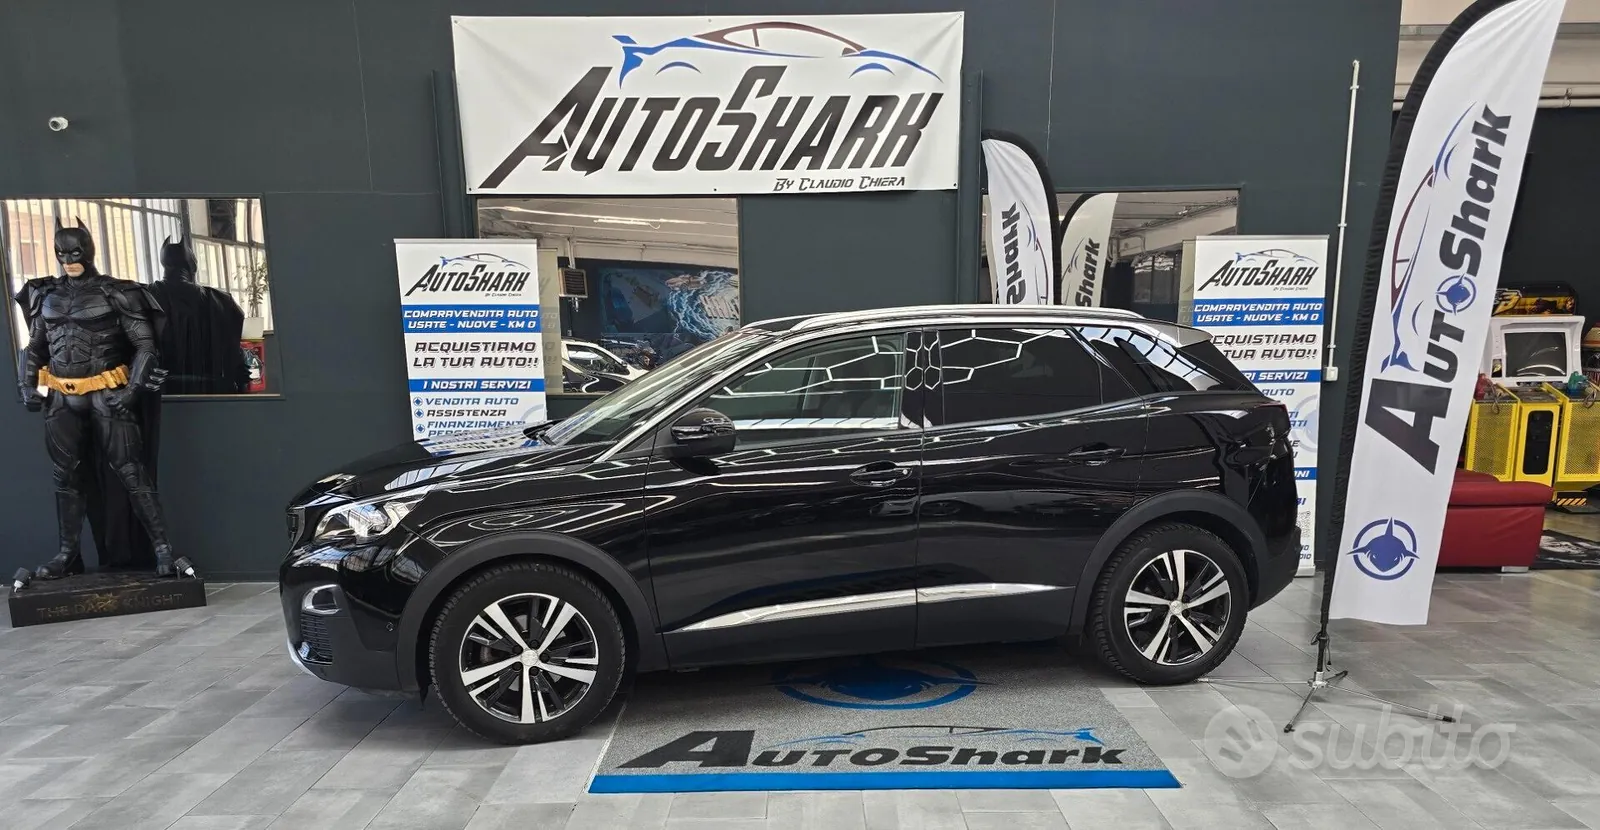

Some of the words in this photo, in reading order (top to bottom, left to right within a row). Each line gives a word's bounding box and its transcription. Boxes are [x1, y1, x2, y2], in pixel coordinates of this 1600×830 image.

[773, 178, 793, 192] BY
[799, 177, 853, 190] CLAUDIO
[858, 176, 905, 189] CHIERA
[1194, 304, 1290, 312] COMPRAVENDITA
[404, 310, 504, 318] COMPRAVENDITA
[507, 310, 538, 318] AUTO
[408, 321, 447, 329] USATE
[457, 321, 497, 329] NUOVE
[1212, 334, 1316, 345] CQUISTIAMO
[415, 342, 536, 355] ACQUISTIAMO
[1223, 349, 1256, 359] TUA
[1261, 349, 1317, 358] AUTO!!
[413, 357, 435, 368] LA
[441, 357, 475, 368] TUA
[480, 357, 538, 368] AUTO!!
[1258, 372, 1308, 380] SERVIZI
[423, 381, 428, 389] I
[431, 381, 476, 389] NOSTRI
[480, 381, 531, 389] SERVIZI
[427, 409, 507, 417] ASSISTENZA
